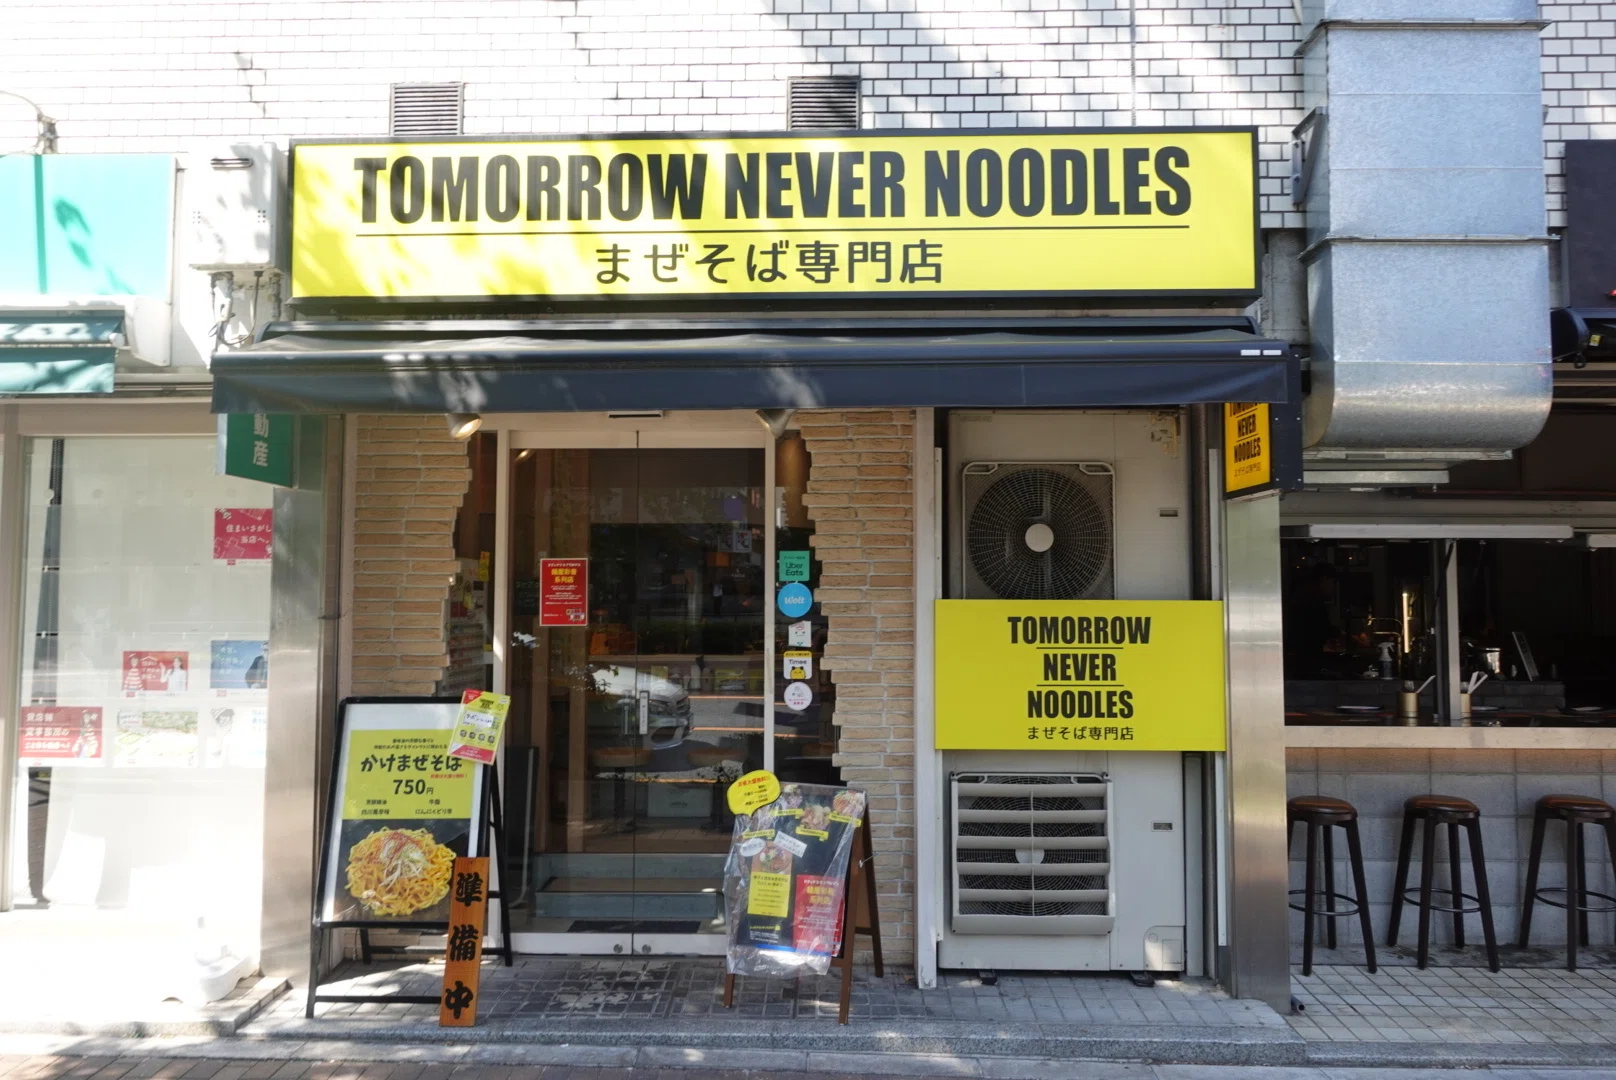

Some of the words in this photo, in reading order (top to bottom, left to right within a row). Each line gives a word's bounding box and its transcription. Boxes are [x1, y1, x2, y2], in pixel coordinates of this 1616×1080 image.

[354, 152, 708, 224] TOMORROW
[724, 149, 906, 220] NEVER
[924, 145, 1191, 218] NOODLES
[596, 239, 943, 284] まぜそば専門店
[1237, 413, 1257, 438] NEVER
[1233, 436, 1261, 463] NOODLES
[785, 569, 804, 577] Eats
[1007, 615, 1152, 644] TOMORROW
[1043, 653, 1117, 681] NEVER
[1027, 690, 1134, 719] NOODLES
[1027, 726, 1134, 741] まぜそば専門店
[392, 778, 434, 795] 750円
[445, 871, 483, 1021] 準備中
